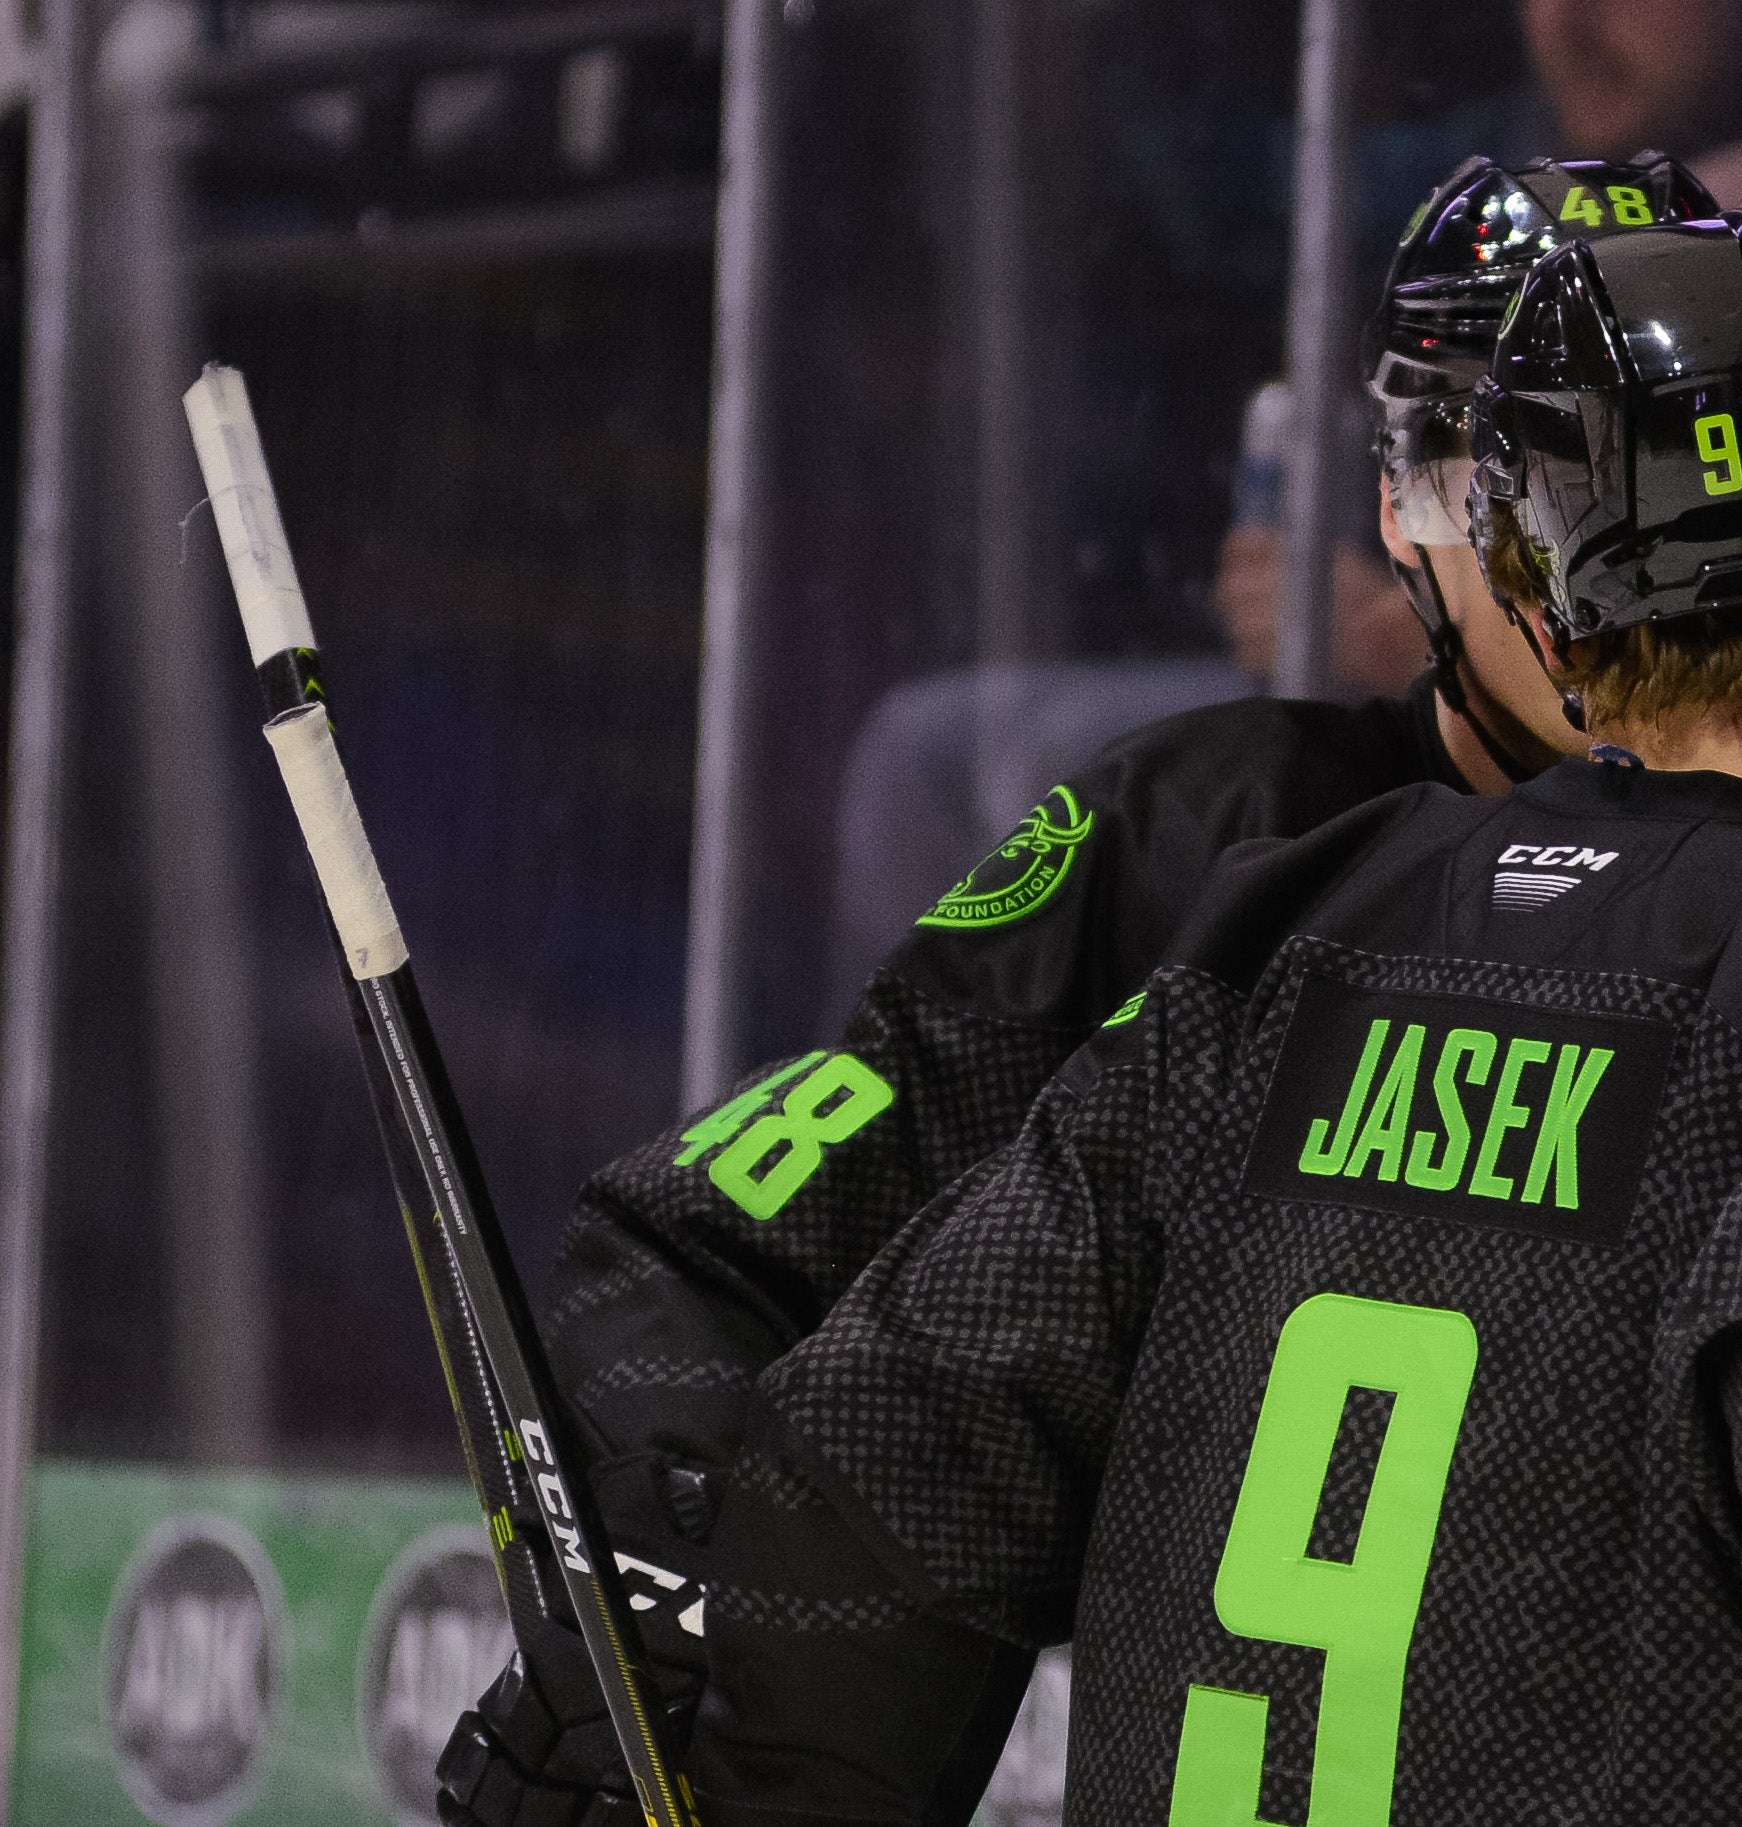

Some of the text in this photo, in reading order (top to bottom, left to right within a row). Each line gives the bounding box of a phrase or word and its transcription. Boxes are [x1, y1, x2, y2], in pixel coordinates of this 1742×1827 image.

[1559, 186, 1654, 228] 48
[932, 865, 1056, 919] FOUNDATION
[1497, 844, 1620, 872] CCM
[672, 1049, 896, 1221] 48
[1298, 1019, 1615, 1210] JASEK
[519, 1417, 593, 1574] CCM
[1168, 1292, 1479, 1827] 9
